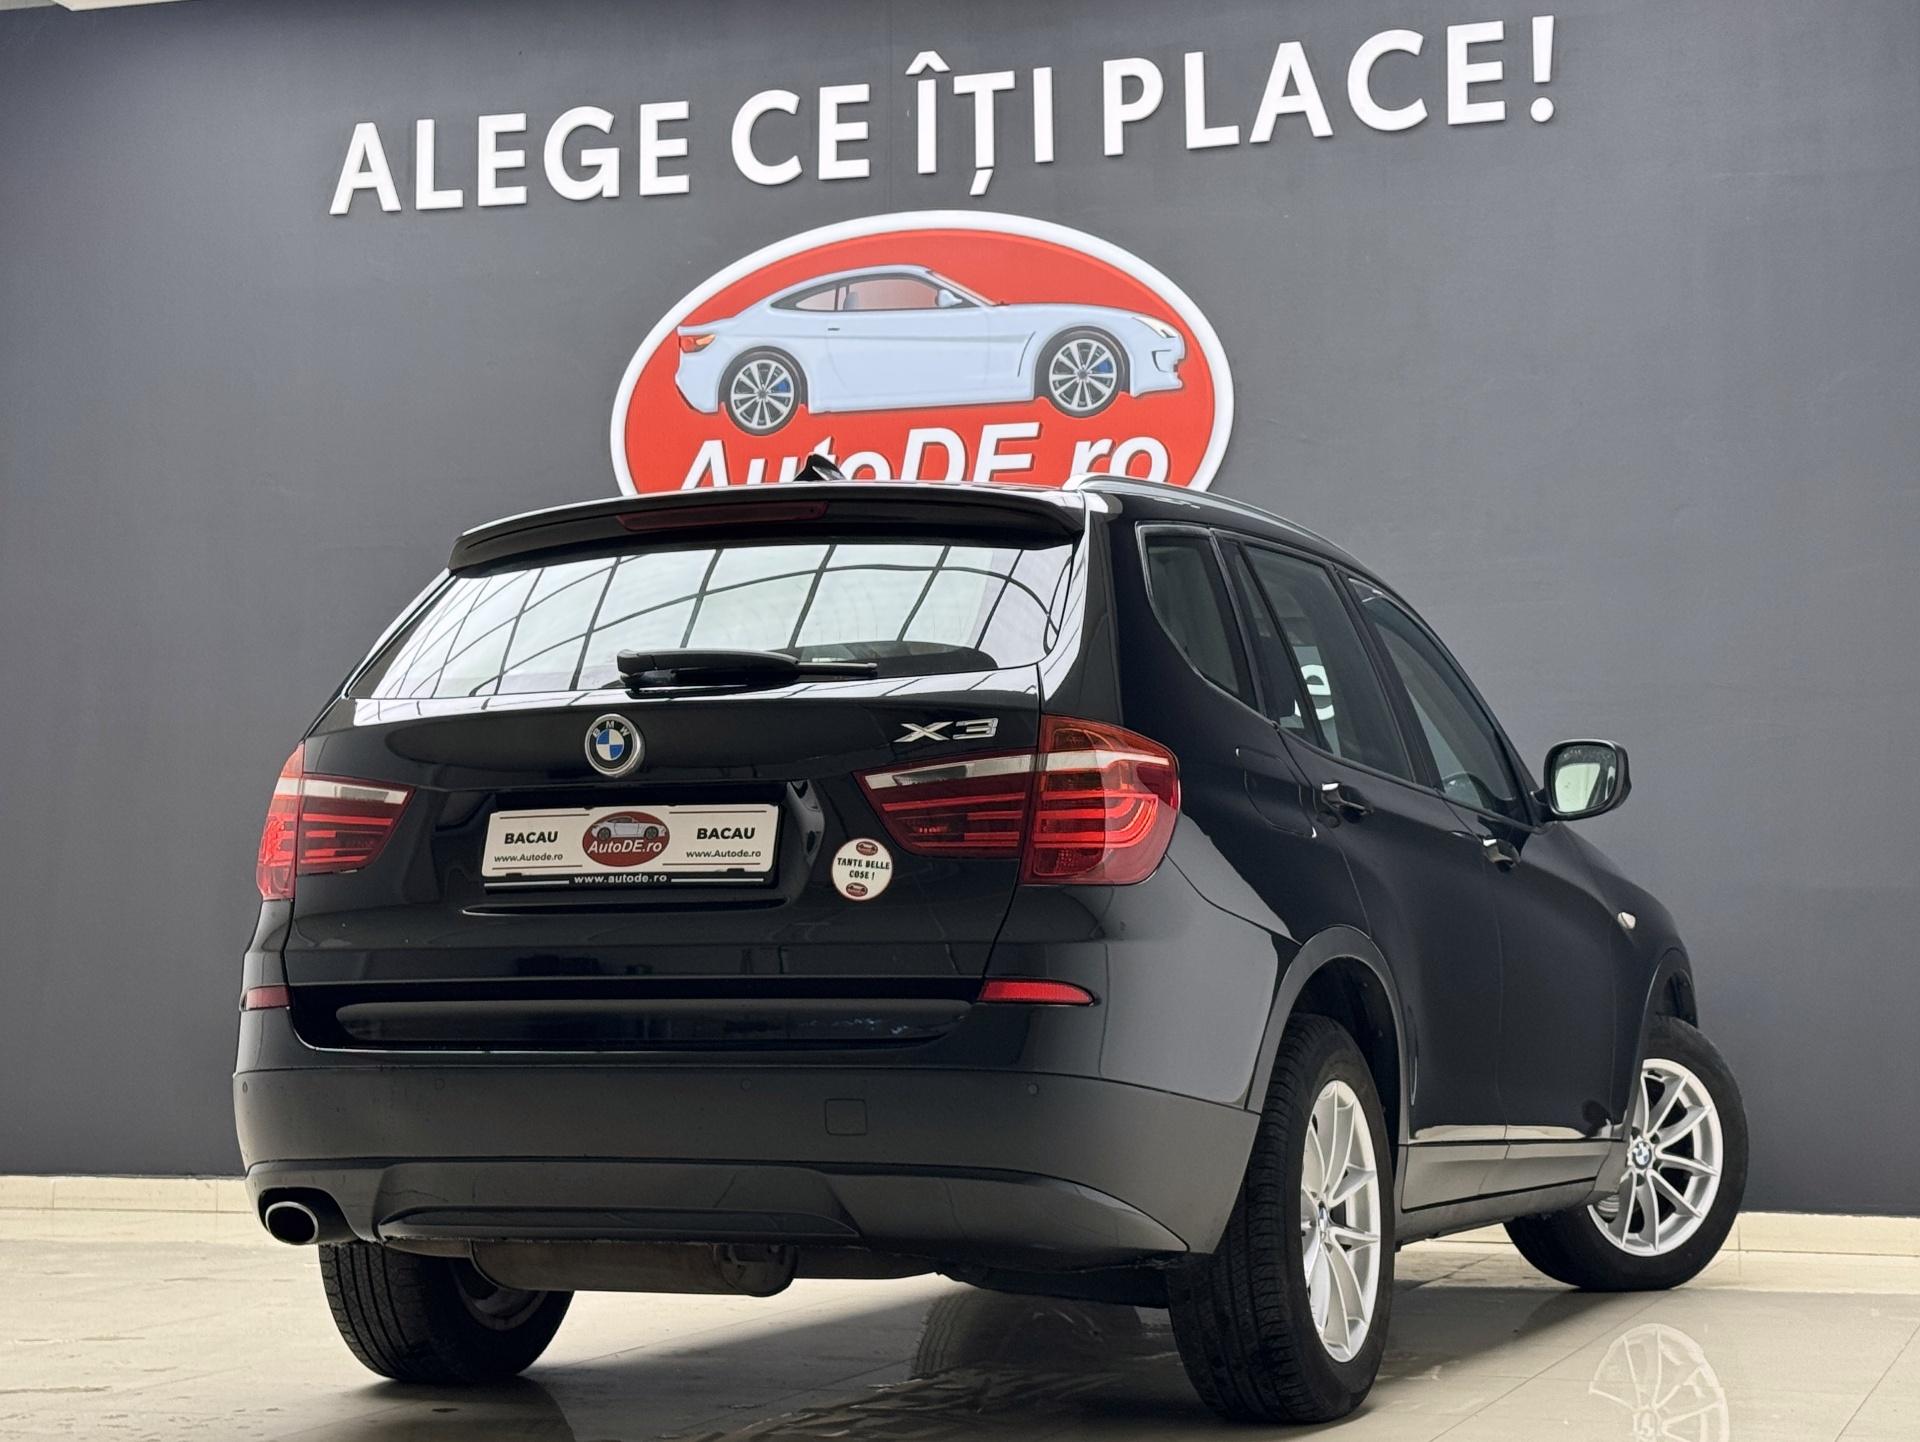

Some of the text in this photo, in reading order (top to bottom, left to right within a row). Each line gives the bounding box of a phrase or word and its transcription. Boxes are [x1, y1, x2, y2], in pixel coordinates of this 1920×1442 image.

[330, 101, 690, 215] ALEGE
[731, 83, 870, 185] CE
[1102, 14, 1555, 156] PLACE!
[592, 720, 631, 738] BMW
[893, 718, 999, 742] X3
[504, 830, 559, 845] BACAU
[696, 827, 756, 840] BACAU
[587, 839, 663, 854] AutoDE.ro
[494, 852, 563, 863] www.Autode.ro
[686, 849, 762, 859] www.Autode.ro
[837, 857, 891, 871] TANTE BELLE
[574, 873, 668, 884] www.autode.ro
[849, 870, 869, 880] COSE
